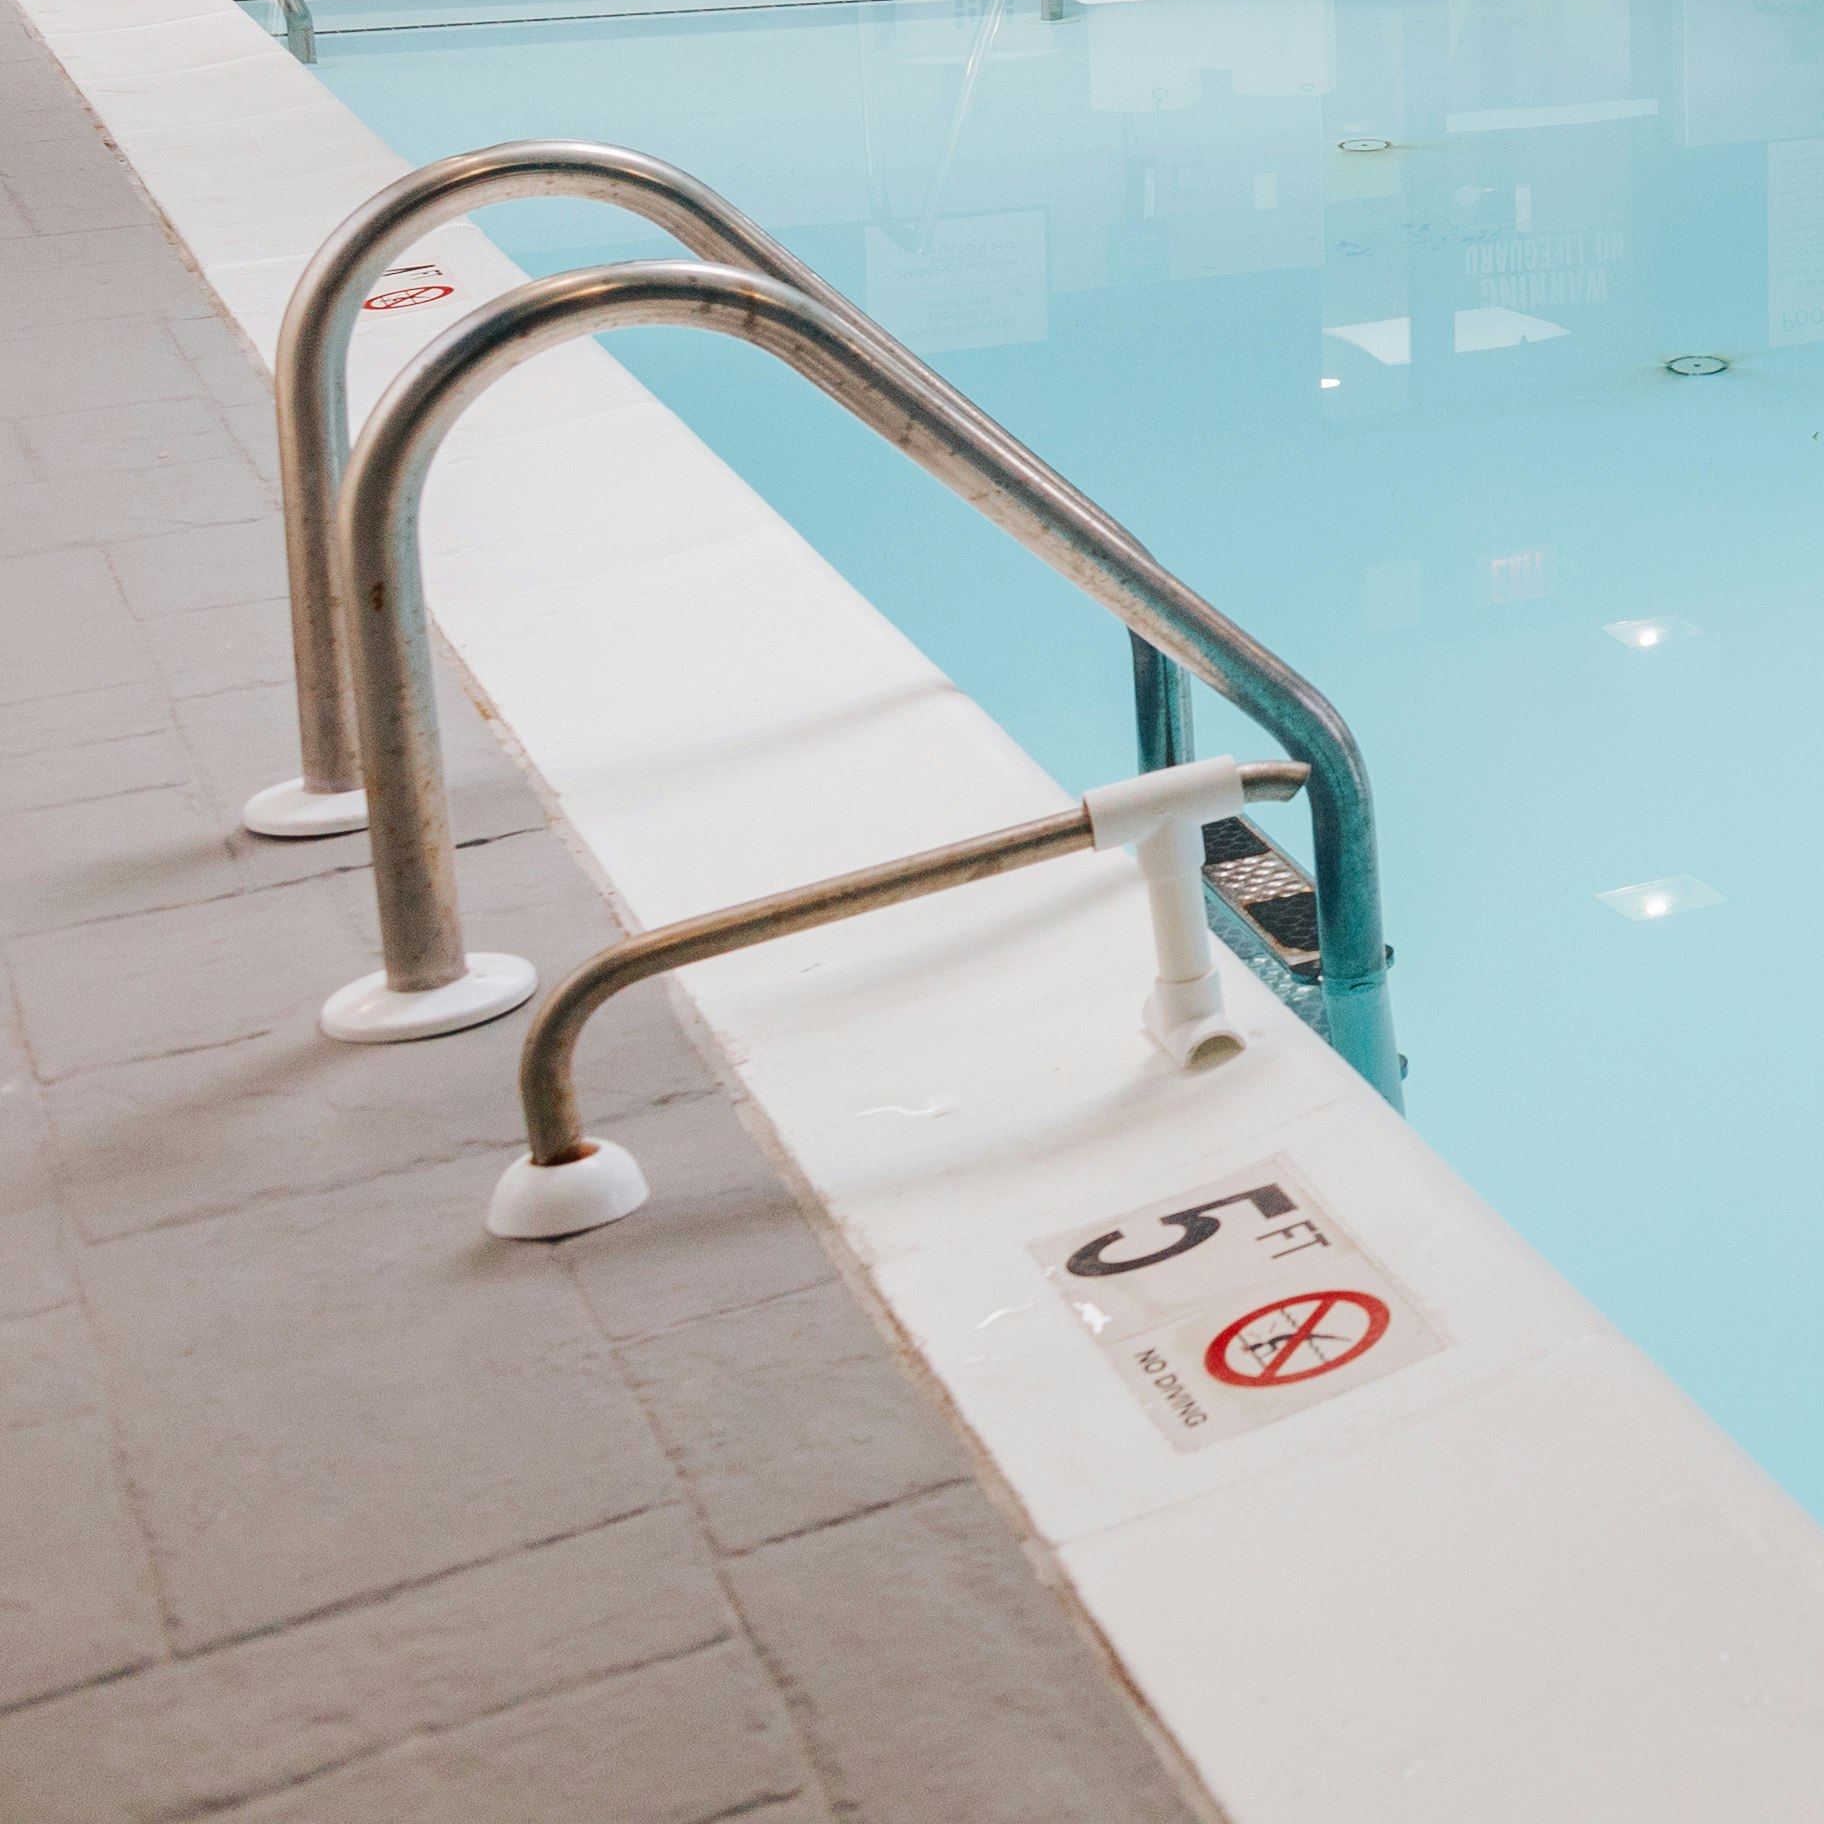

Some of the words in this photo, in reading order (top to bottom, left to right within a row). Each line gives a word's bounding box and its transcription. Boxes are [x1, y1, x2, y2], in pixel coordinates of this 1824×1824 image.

[1065, 1183, 1298, 1276] 5
[1256, 1220, 1331, 1260] FT
[1133, 1348, 1168, 1375] NO
[1154, 1373, 1207, 1428] DIVING
